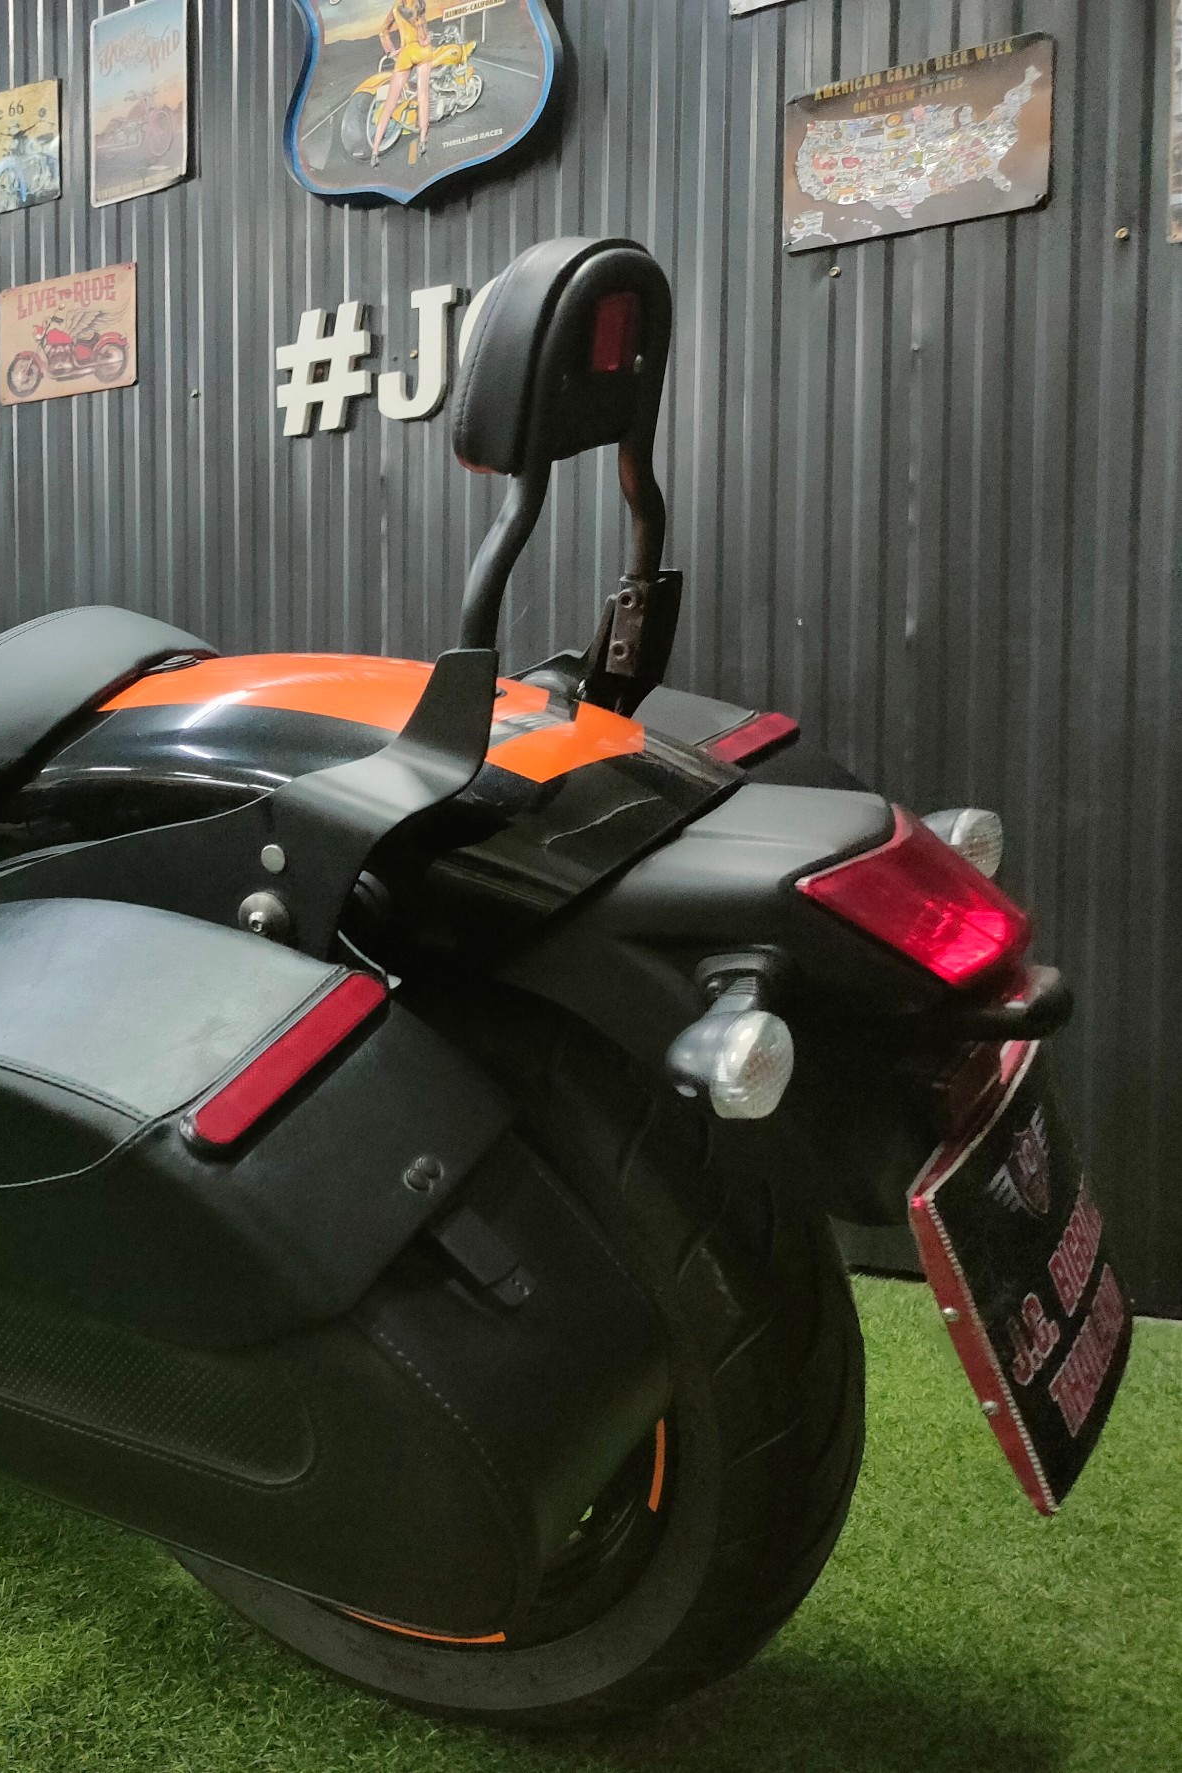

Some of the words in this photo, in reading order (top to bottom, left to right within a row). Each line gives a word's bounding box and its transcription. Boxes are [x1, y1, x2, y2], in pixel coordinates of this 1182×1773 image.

[814, 73, 881, 101] AMERICAN
[887, 63, 929, 83] CRAFT
[935, 48, 969, 71] BEER
[974, 39, 1014, 61] WEEK
[8, 99, 25, 118] 66
[852, 97, 879, 114] ONLY
[884, 88, 915, 106] BREW
[442, 133, 479, 148] THRILLING
[479, 128, 504, 140] RACES
[18, 287, 57, 320] LIVE
[73, 274, 116, 308] RIDE
[276, 284, 502, 437] #J
